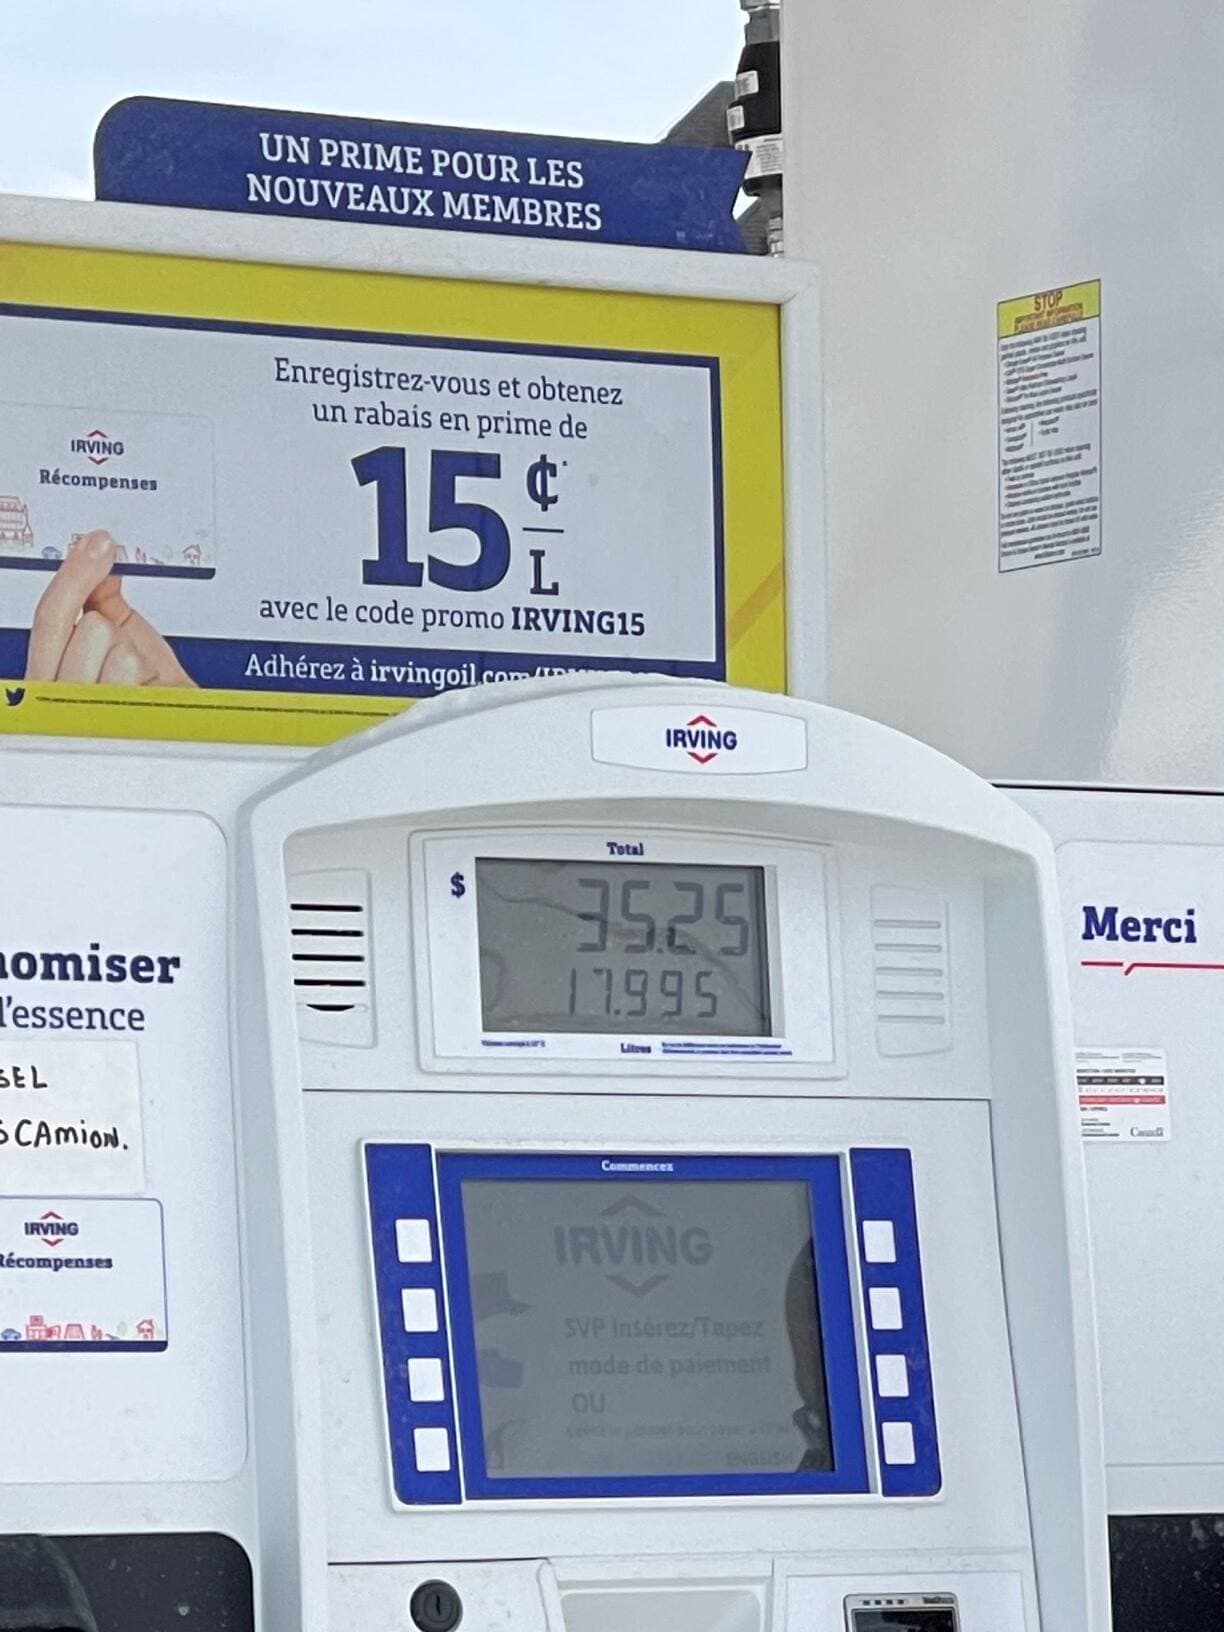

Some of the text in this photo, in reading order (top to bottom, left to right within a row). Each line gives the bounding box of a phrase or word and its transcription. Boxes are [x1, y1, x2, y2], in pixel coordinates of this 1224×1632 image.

[259, 133, 584, 188] UN PRIME POUR LES
[246, 173, 602, 231] NOUVEAUX MEMBRES
[1034, 290, 1063, 312] STOP
[274, 357, 623, 405] Enregistrez-vous et obtenez
[313, 401, 589, 439] un rabais en prime de
[71, 439, 125, 456] IRVING
[40, 469, 158, 491] Récompenses
[350, 446, 512, 592] 15
[529, 550, 560, 596] L
[260, 596, 645, 636] avec le code promo IRVING15
[245, 653, 346, 683] Adhérez
[351, 659, 366, 682] à
[665, 728, 737, 751] IRVING
[606, 841, 645, 857] Total
[450, 872, 466, 898] $
[575, 878, 749, 957] 35.25
[1081, 905, 1198, 944] Merci
[564, 967, 717, 1018] 17.995
[620, 1042, 652, 1055] Litres
[24, 1222, 79, 1236] IRVING
[554, 1225, 713, 1265] IRVING
[565, 1317, 606, 1339] SVP
[568, 1355, 771, 1378] mode de paiement
[571, 1391, 606, 1414] OU
